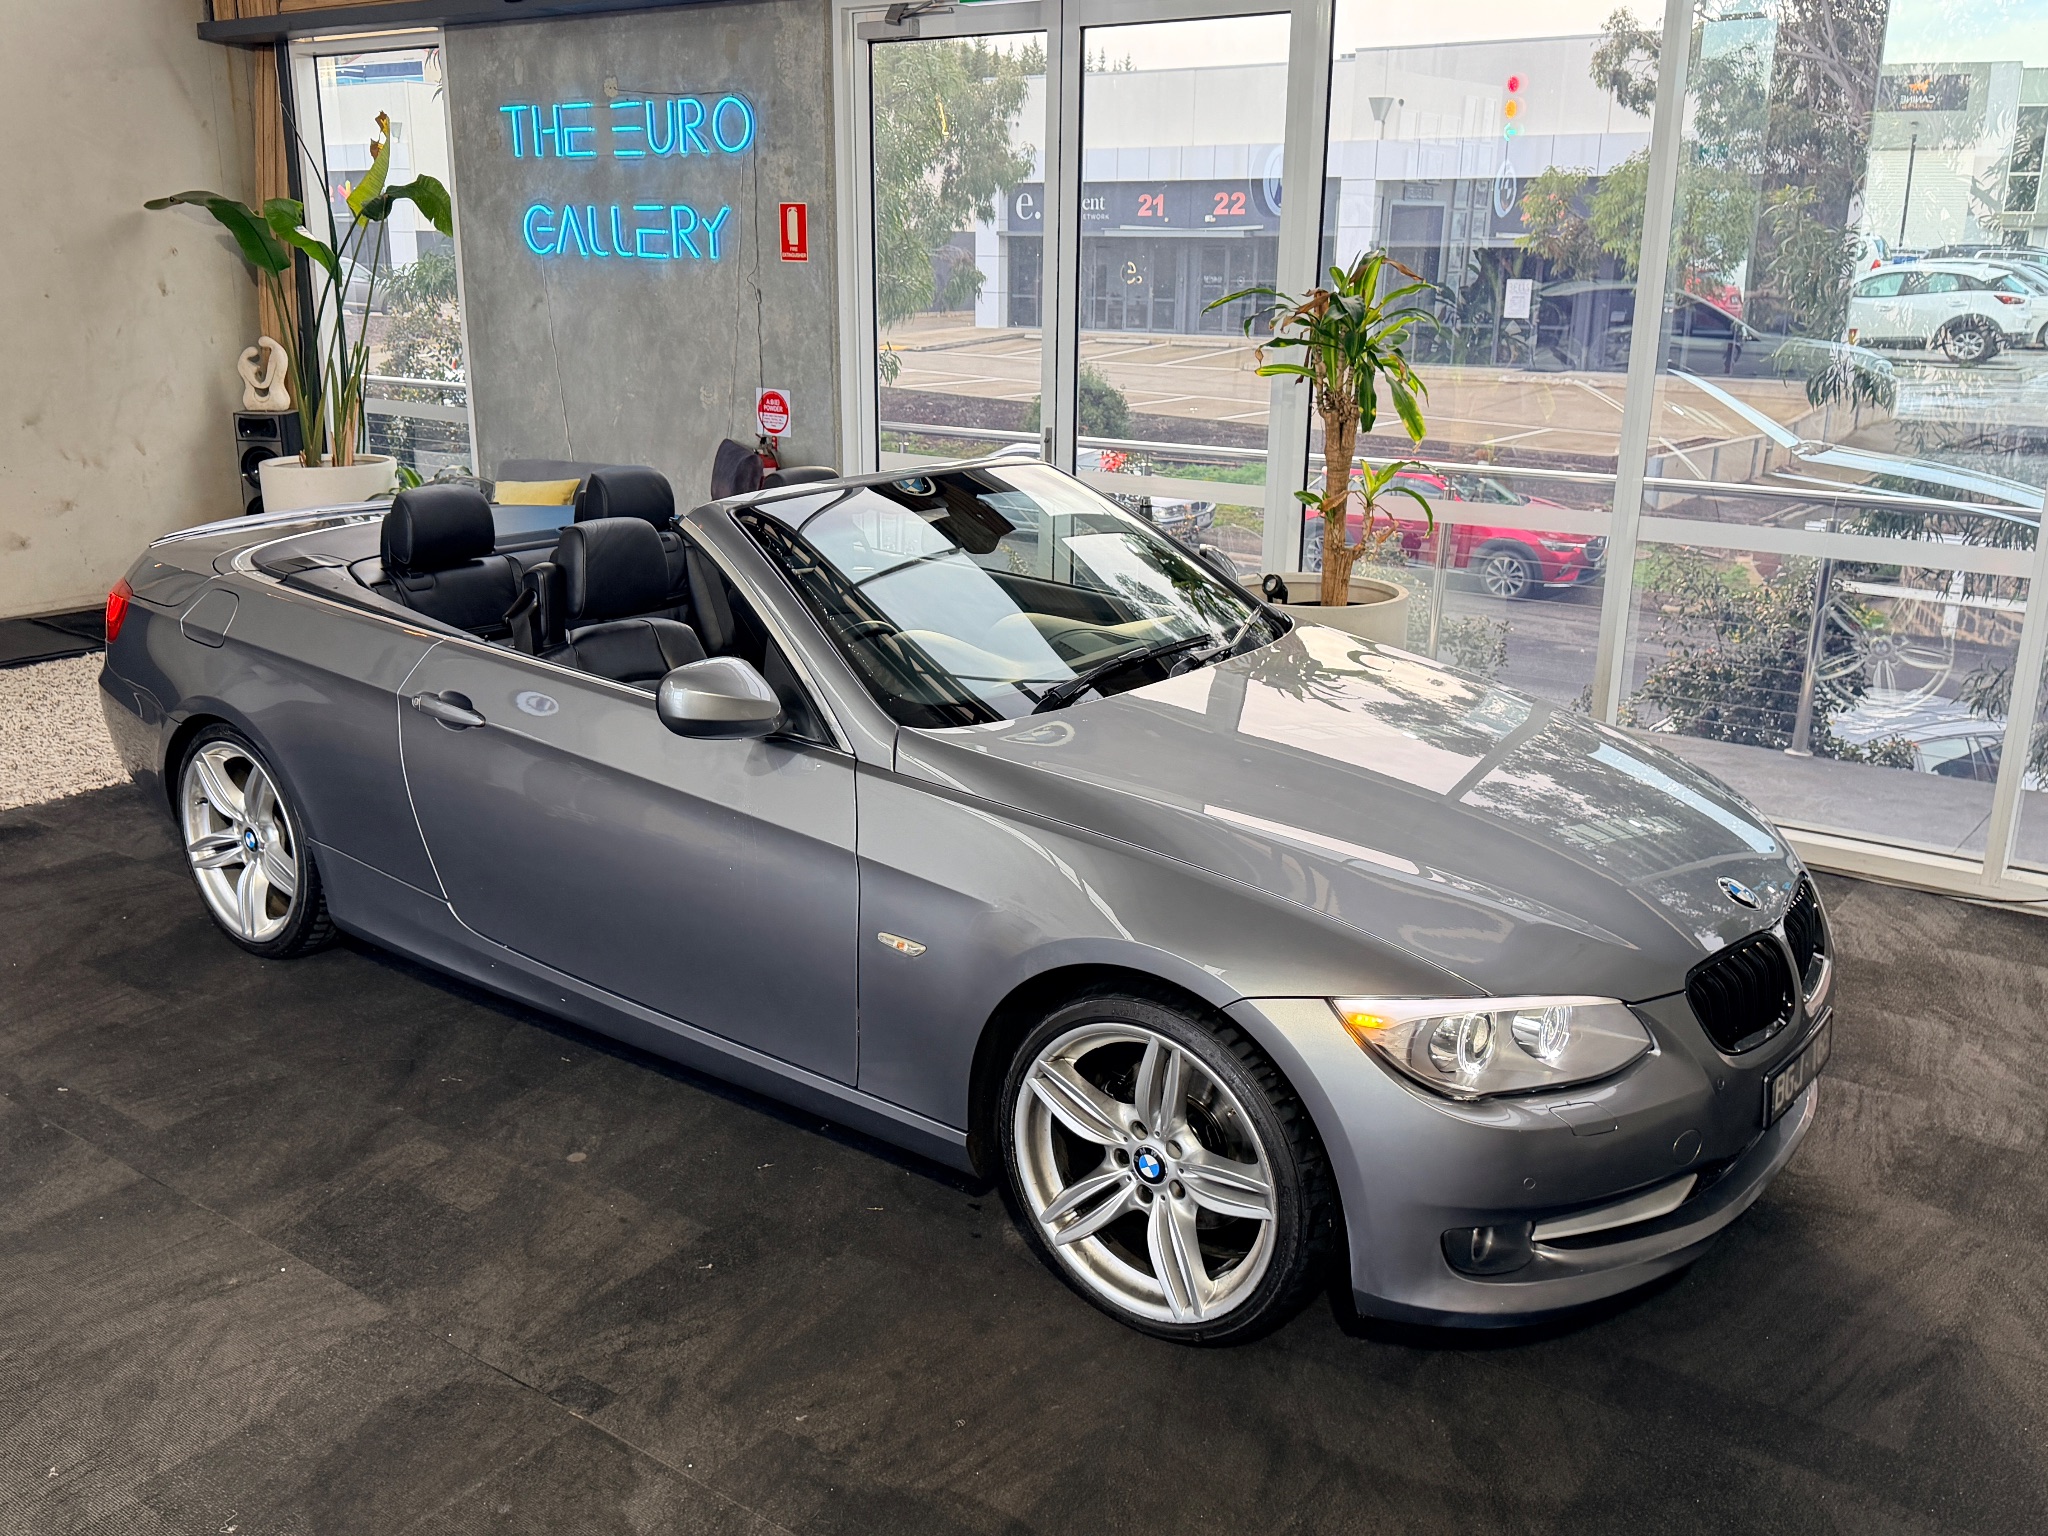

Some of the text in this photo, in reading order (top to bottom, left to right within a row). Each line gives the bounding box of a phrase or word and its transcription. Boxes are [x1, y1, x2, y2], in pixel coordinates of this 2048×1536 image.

[500, 96, 755, 157] THE EURO
[1137, 193, 1165, 217] 21
[1213, 191, 1246, 216] 22
[523, 204, 732, 260] GALLERY
